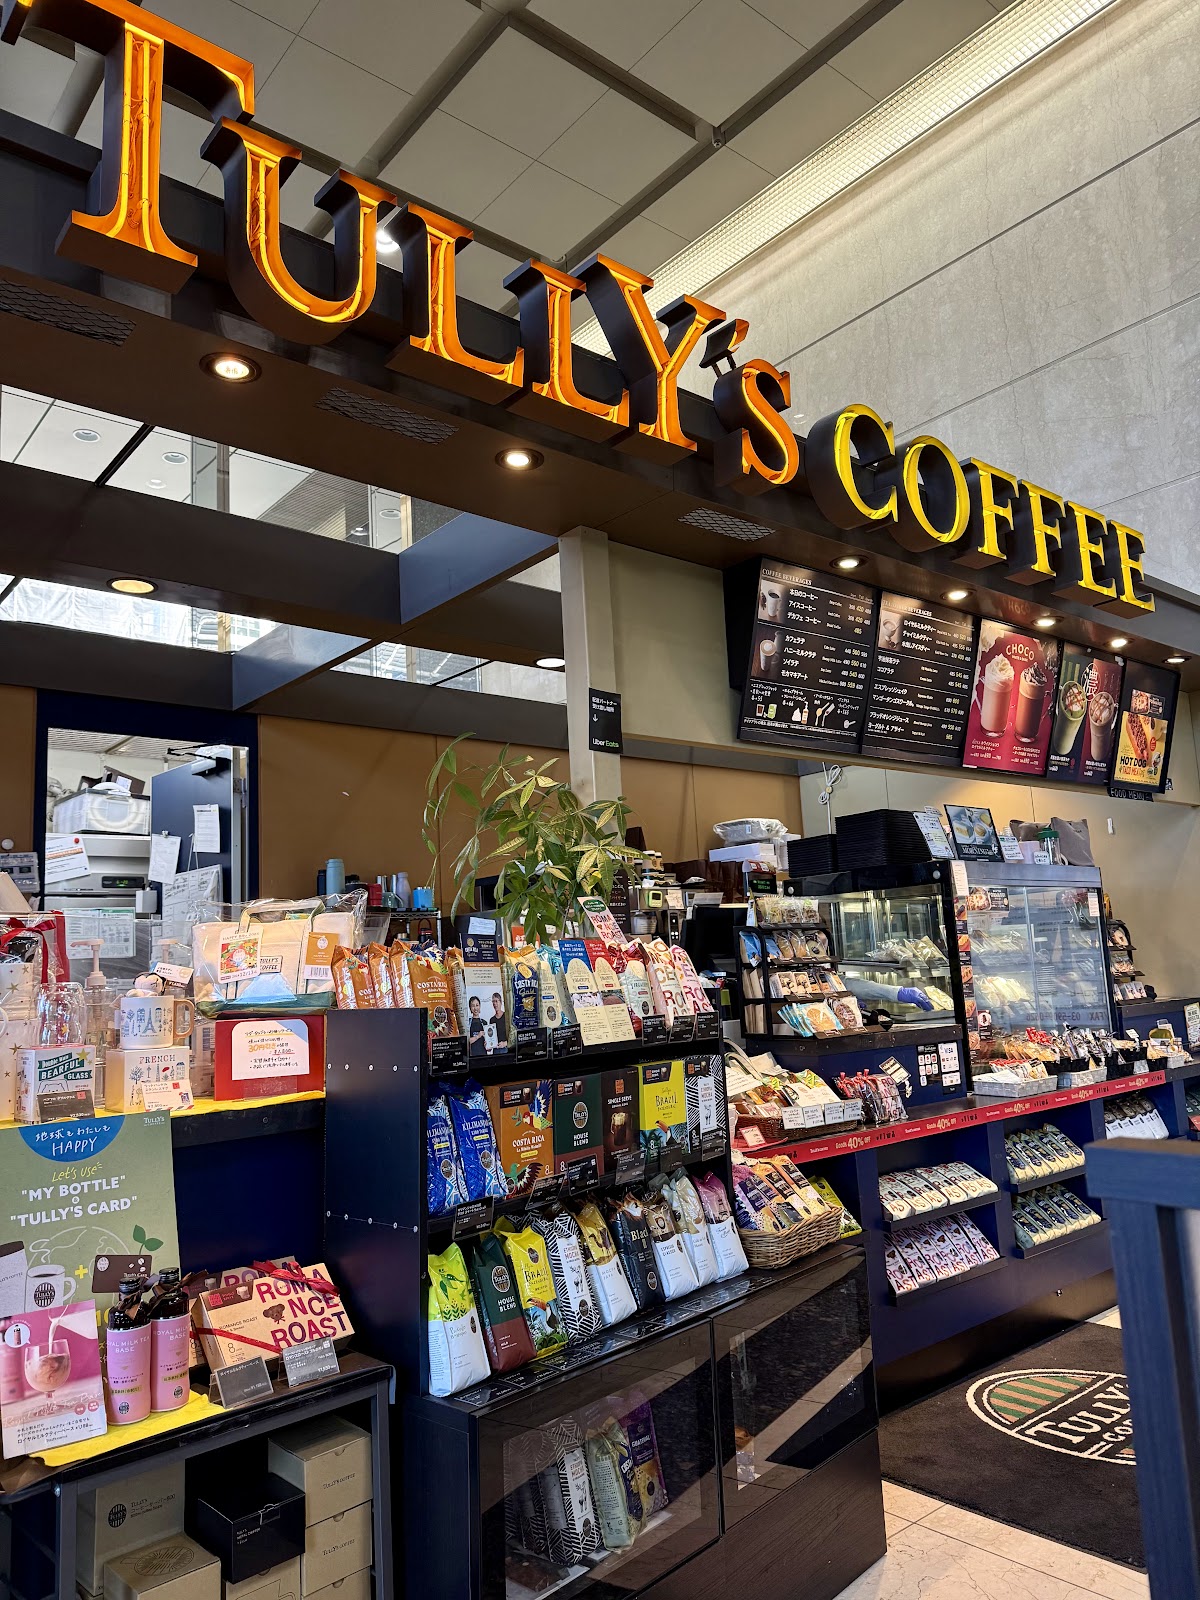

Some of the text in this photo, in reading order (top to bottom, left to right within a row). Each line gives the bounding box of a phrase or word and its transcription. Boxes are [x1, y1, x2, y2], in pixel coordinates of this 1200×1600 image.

[15, 0, 1156, 613] TULLY'S COFFEE
[788, 600, 817, 612] アイスコーヒー
[1006, 643, 1035, 661] CHOCO
[592, 737, 620, 748] Uber Eats
[1120, 755, 1133, 766] HOT
[1133, 758, 1147, 768] DOG
[1110, 787, 1127, 799] FOOD
[139, 1054, 176, 1065] FRENCH
[41, 1060, 81, 1080] BEARFUL
[67, 1072, 89, 1080] GLASS
[655, 1092, 678, 1107] BRAZIL
[936, 1118, 951, 1130] 40%
[512, 1134, 545, 1147] COSTA RICA
[573, 1131, 589, 1141] HOUSE
[52, 1136, 98, 1157] HAPPY
[573, 1138, 589, 1147] BLEND
[847, 1136, 864, 1149] 40%
[52, 1166, 77, 1183] Let's
[21, 1174, 126, 1202] "MY BOTTLE"
[10, 1195, 138, 1227] "TULLY'S CARD"
[497, 1295, 515, 1306] HOUSE
[270, 1310, 346, 1349] ROAST
[169, 1331, 187, 1341] BASE
[121, 1338, 139, 1347] MILK
[227, 1342, 236, 1354] 8
[115, 1346, 135, 1354] BASE
[1025, 1383, 1130, 1444] TULLY'
